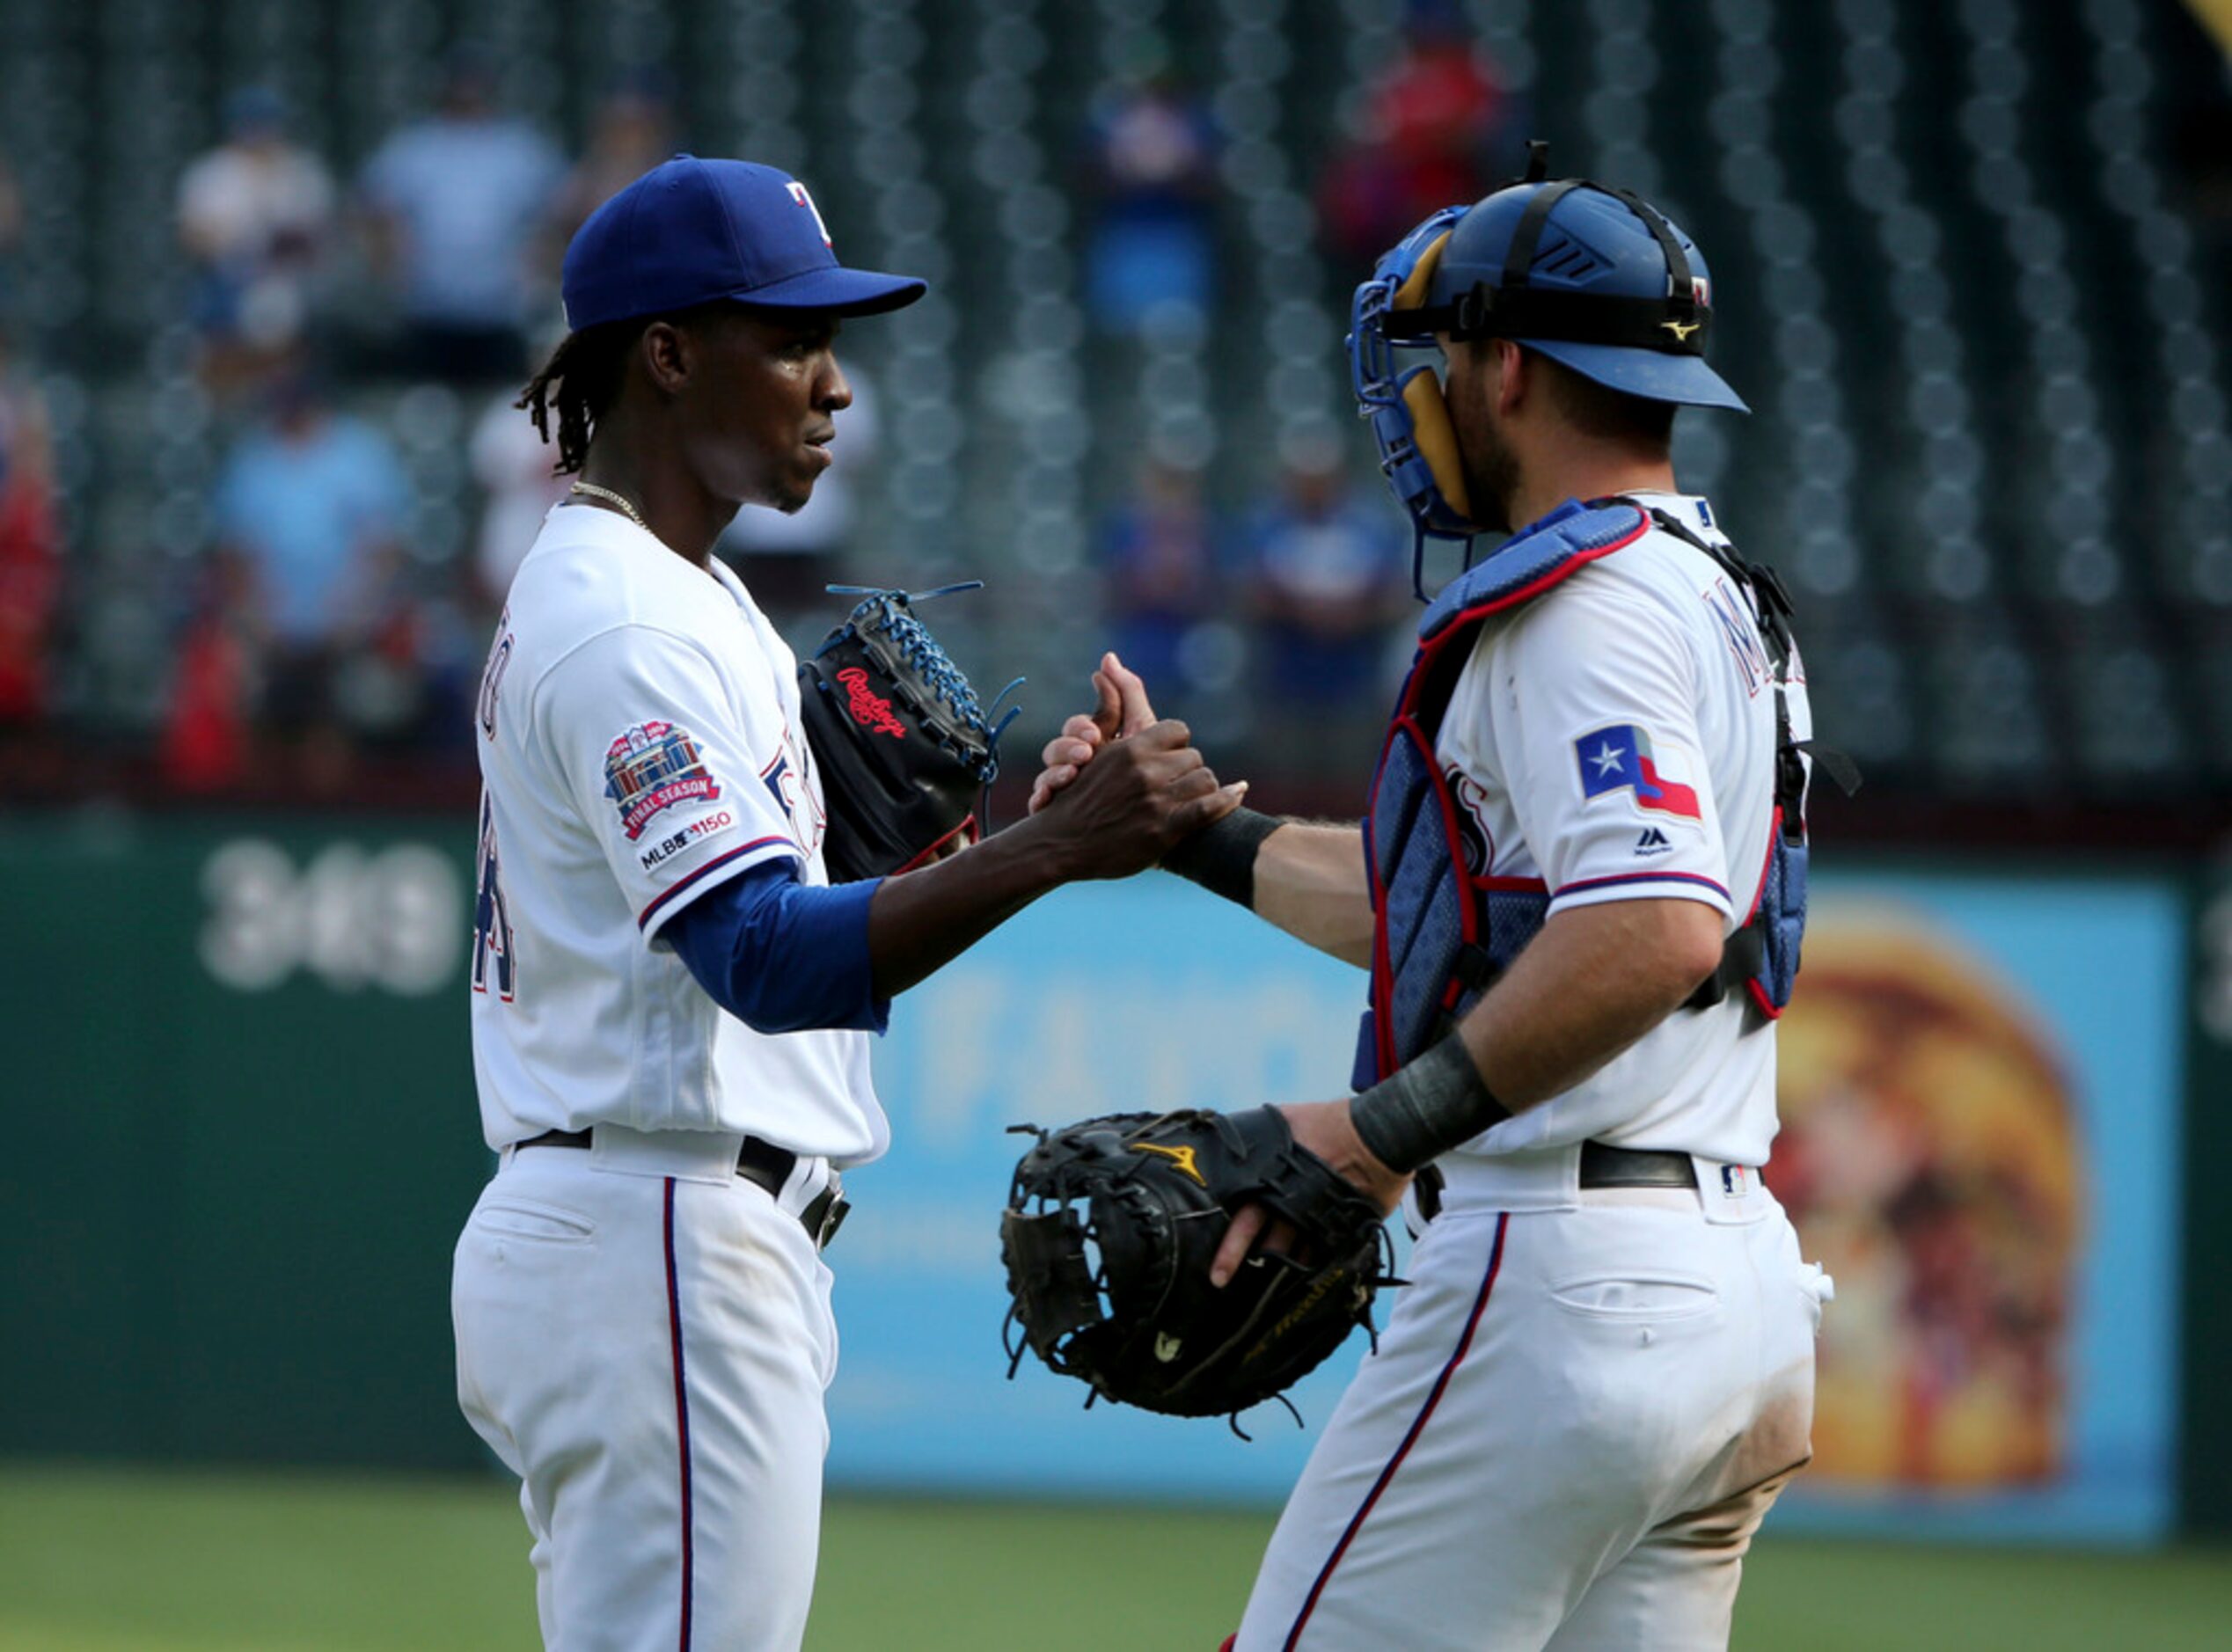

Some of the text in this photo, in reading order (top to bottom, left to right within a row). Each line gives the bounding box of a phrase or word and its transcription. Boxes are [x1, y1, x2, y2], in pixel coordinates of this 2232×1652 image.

[836, 666, 908, 741] Rawlings
[627, 779, 707, 829] FINAL SEASON
[641, 840, 677, 870] MLB
